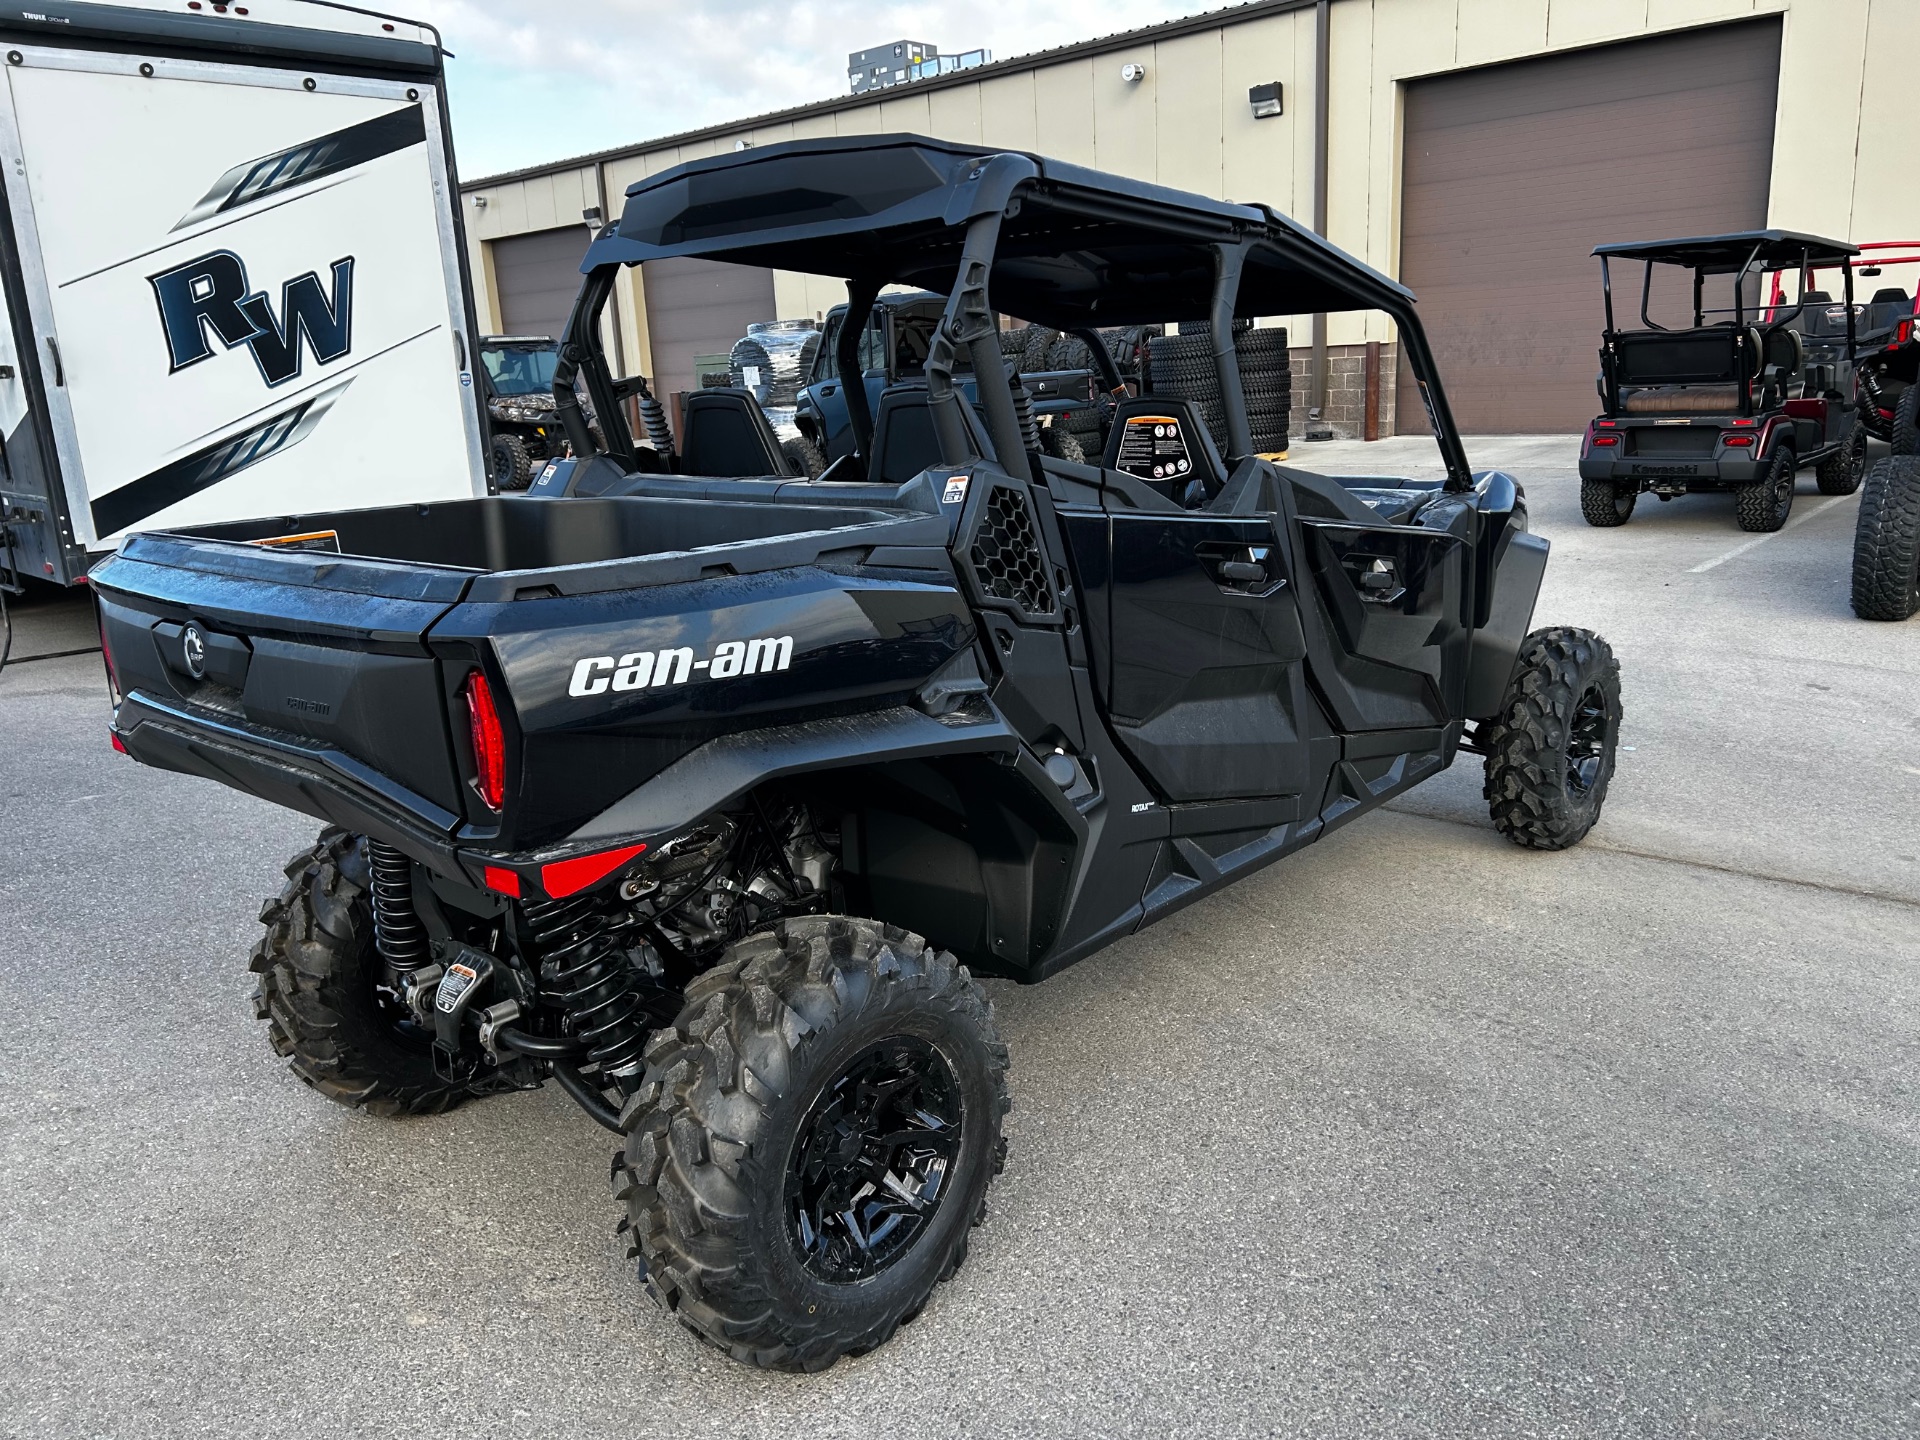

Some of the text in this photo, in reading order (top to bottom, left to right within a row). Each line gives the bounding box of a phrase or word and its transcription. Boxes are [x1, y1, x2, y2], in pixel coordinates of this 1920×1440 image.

[144, 249, 355, 389] RW
[1631, 464, 1698, 475] Kawasaki
[190, 652, 204, 662] BRP
